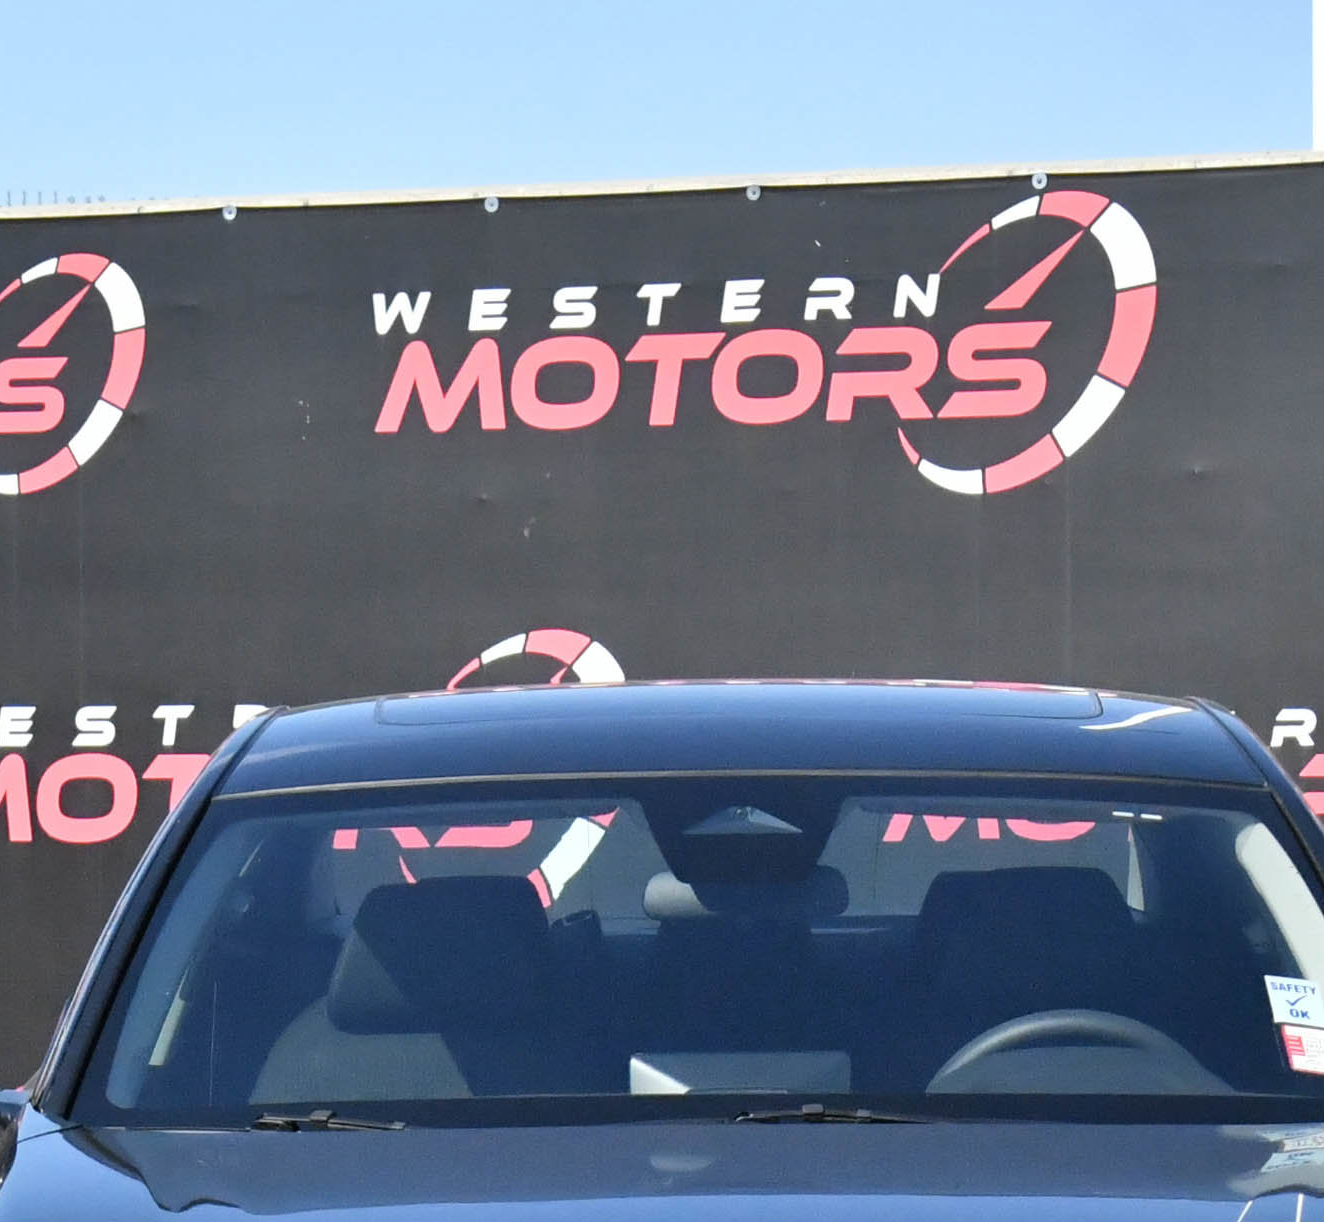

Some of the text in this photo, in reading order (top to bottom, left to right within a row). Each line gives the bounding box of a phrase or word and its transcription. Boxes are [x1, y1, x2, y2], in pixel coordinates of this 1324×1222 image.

[372, 273, 941, 335] WESTERN
[374, 320, 1052, 434] MOTORS
[1269, 981, 1317, 996] SAFETY
[1289, 1008, 1311, 1019] OK
